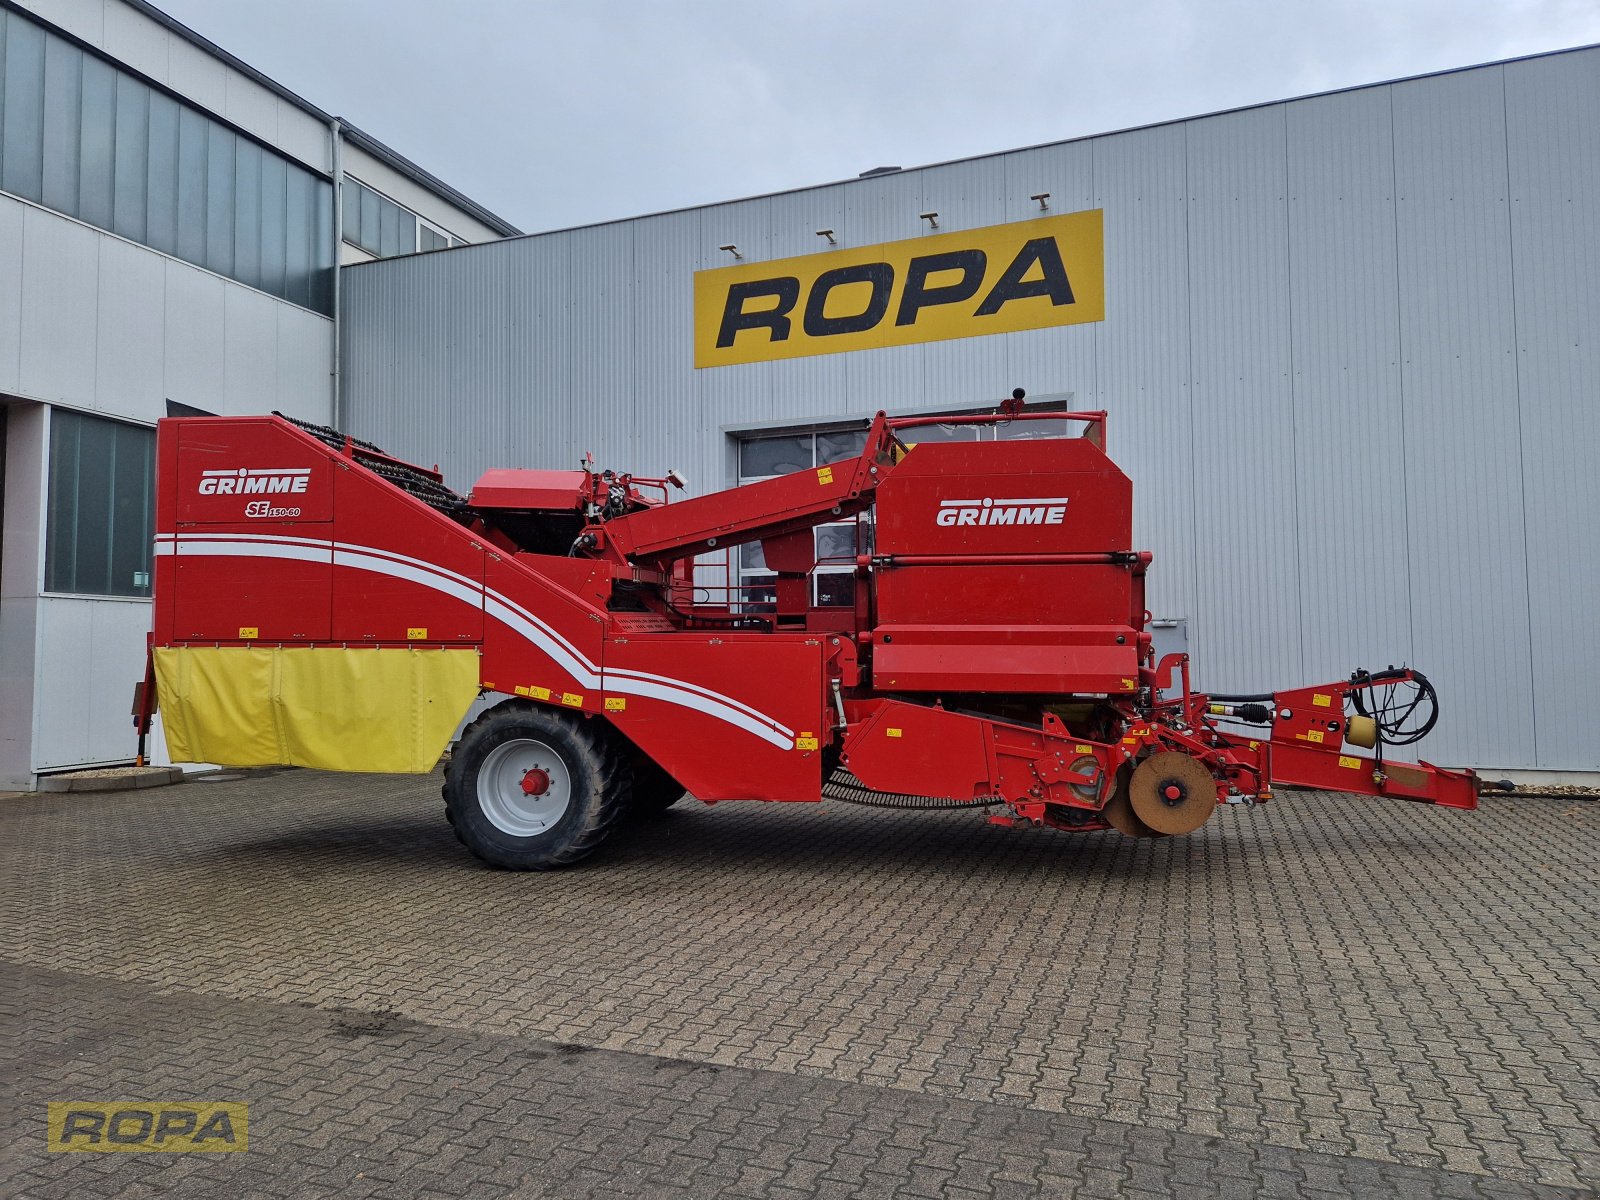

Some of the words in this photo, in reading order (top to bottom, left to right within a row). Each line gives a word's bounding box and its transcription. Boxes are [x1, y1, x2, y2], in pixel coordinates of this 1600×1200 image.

[716, 236, 1076, 348] ROPA
[198, 468, 310, 495] GRIMME
[246, 501, 269, 517] SE
[269, 507, 301, 517] 150-60
[936, 497, 1067, 526] GRIMME
